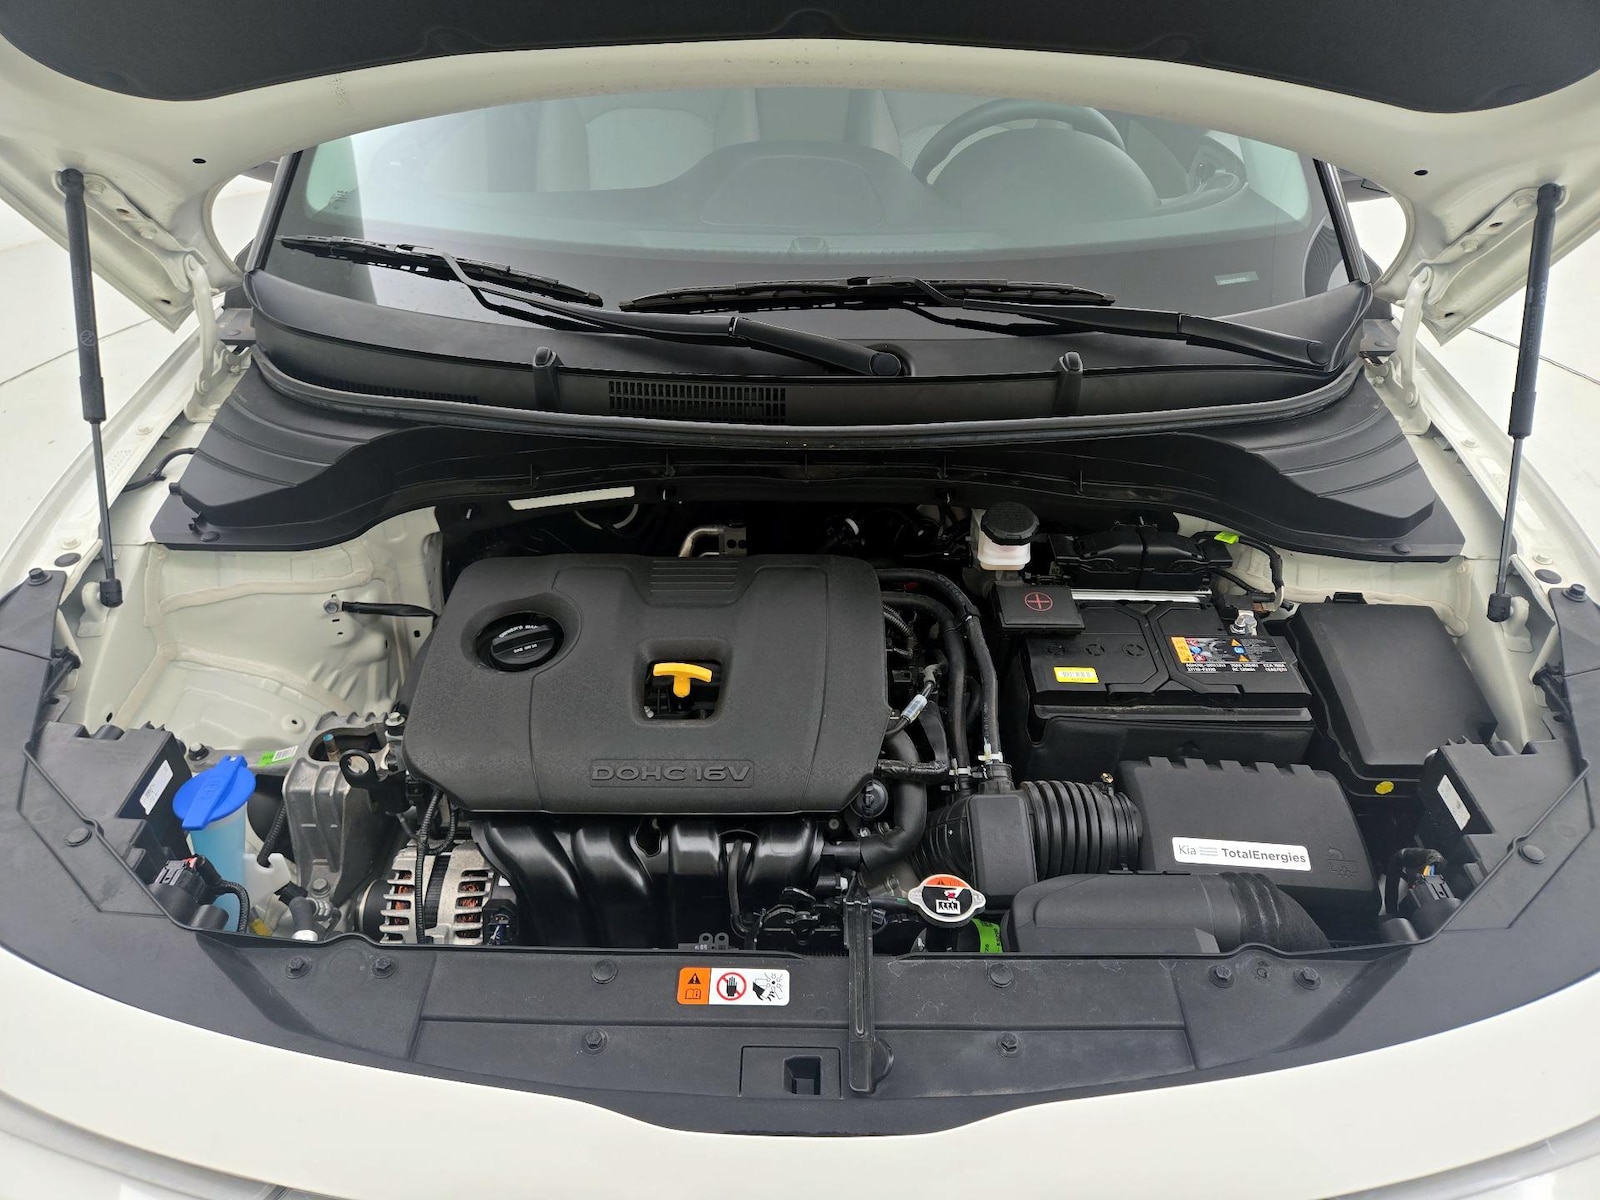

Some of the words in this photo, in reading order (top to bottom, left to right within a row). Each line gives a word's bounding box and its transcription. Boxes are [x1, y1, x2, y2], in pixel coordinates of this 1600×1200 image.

[592, 765, 687, 782] DOHC
[696, 766, 750, 782] 16V
[1178, 844, 1197, 856] Kia
[1221, 848, 1306, 864] TotalEnergies
